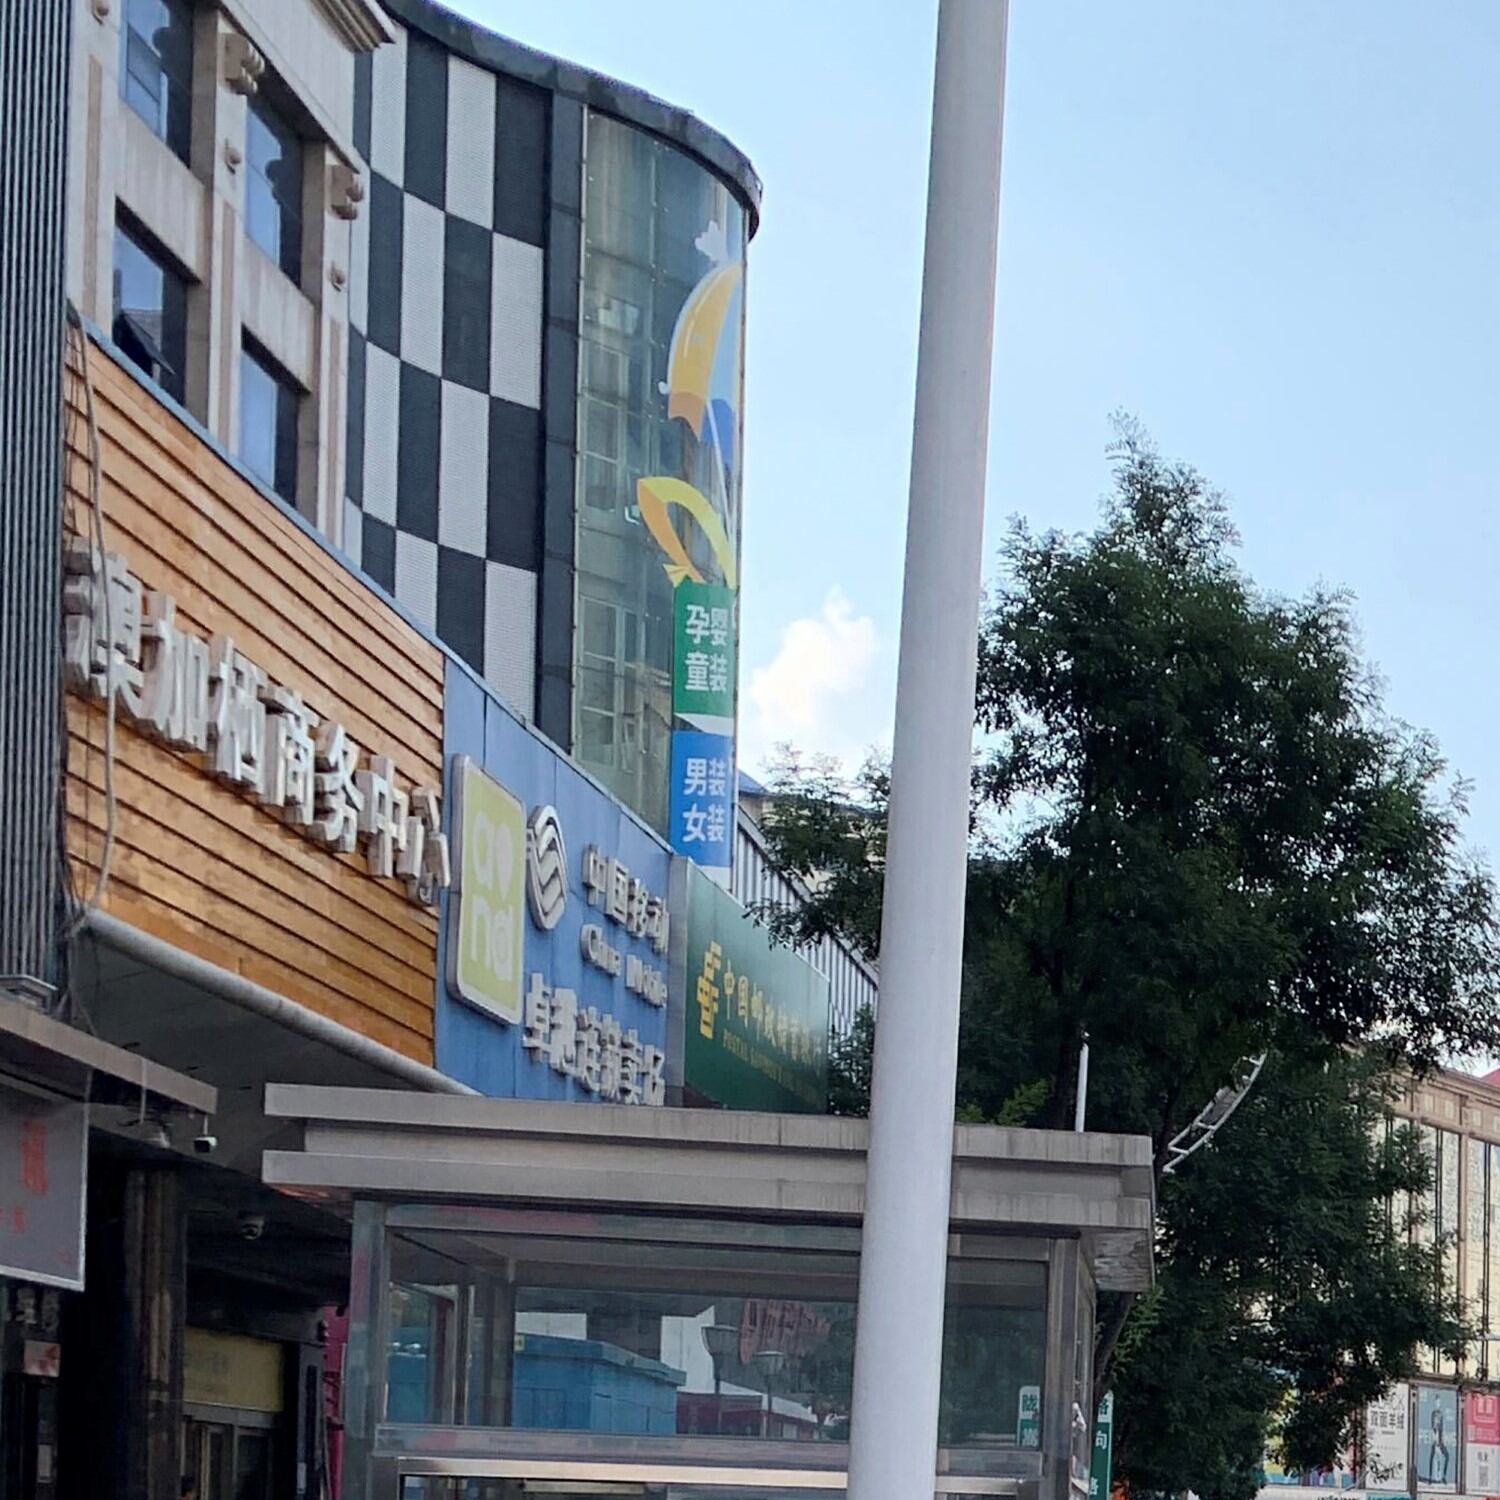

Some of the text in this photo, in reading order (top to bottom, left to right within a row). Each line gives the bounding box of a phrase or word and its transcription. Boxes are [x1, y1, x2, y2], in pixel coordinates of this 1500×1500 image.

[685, 604, 728, 646] 孕婴
[684, 651, 727, 692] 童装
[684, 758, 726, 797] 男装
[682, 803, 725, 842] 女装
[582, 843, 669, 955] 中国移动
